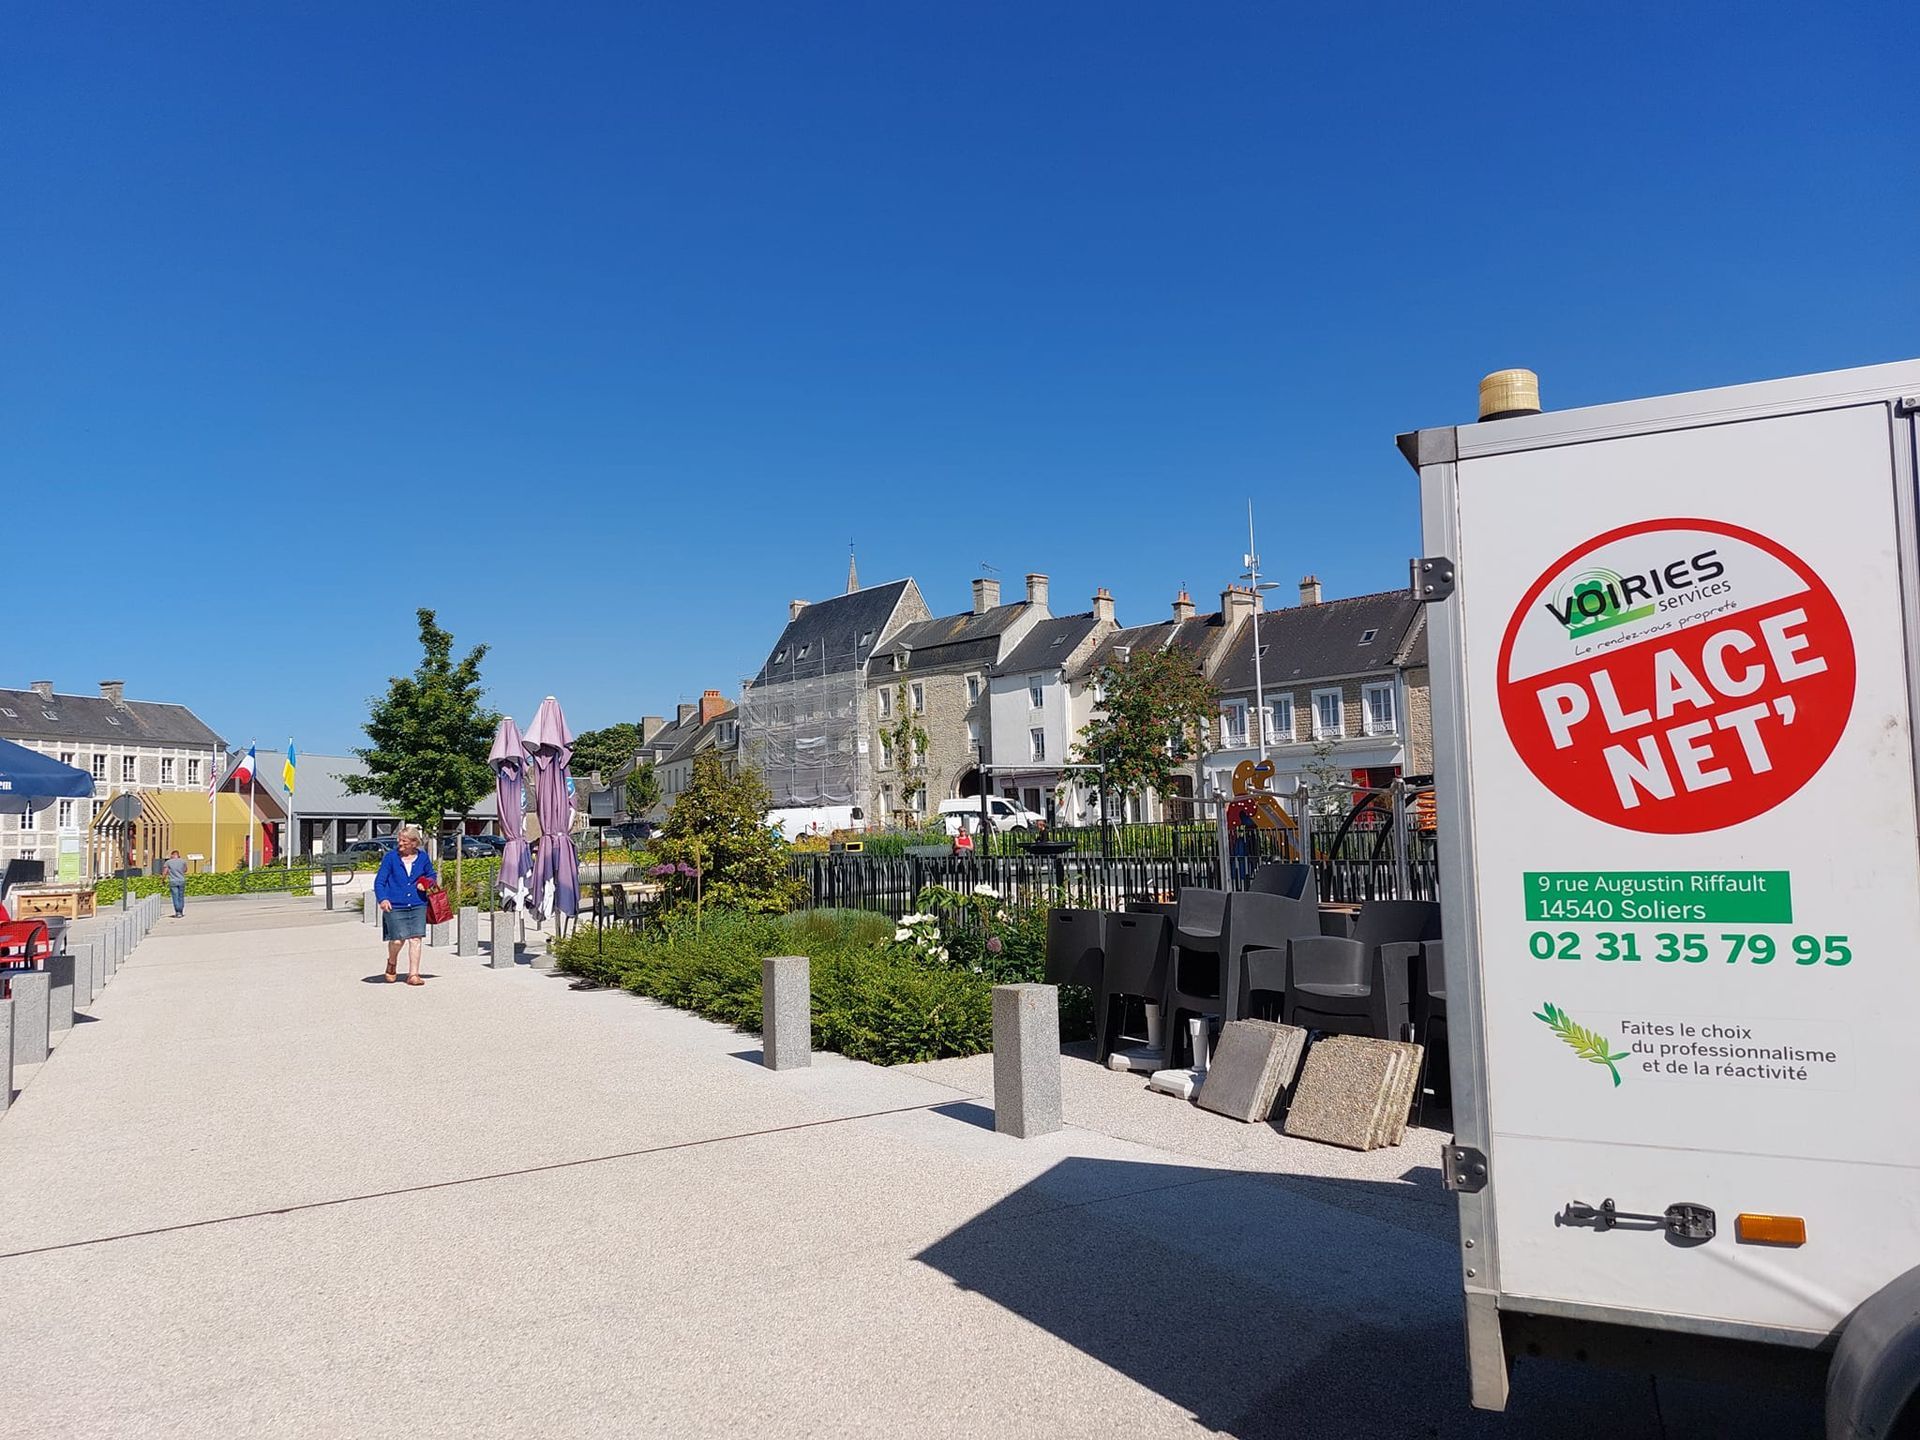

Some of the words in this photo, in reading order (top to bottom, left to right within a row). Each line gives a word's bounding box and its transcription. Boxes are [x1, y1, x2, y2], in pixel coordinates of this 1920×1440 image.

[1545, 550, 1725, 627] VOIRIES
[1658, 580, 1731, 612] services
[1575, 646, 1592, 656] Le
[1597, 621, 1672, 649] rendez-vous
[1536, 608, 1828, 750] PLACE
[1538, 876, 1550, 892] 9
[1556, 879, 1589, 892] rue
[1594, 874, 1684, 896] Augustin
[1690, 875, 1767, 892] Riffault
[1539, 899, 1613, 919] 14540
[1621, 900, 1706, 920] Soliers
[1529, 931, 1581, 960] 02
[1595, 932, 1641, 961] 31
[1655, 933, 1709, 963] 35
[1720, 934, 1776, 964] 79
[1791, 935, 1853, 966] 95
[1621, 1020, 1674, 1037] Faites
[1679, 1023, 1695, 1038] le
[1701, 1024, 1752, 1040] choix
[1631, 1041, 1653, 1055] du
[1660, 1042, 1837, 1064] professionnalisme
[1642, 1060, 1660, 1074] et
[1666, 1060, 1688, 1075] de
[1694, 1061, 1710, 1076] la
[1716, 1061, 1808, 1082] réactivité
